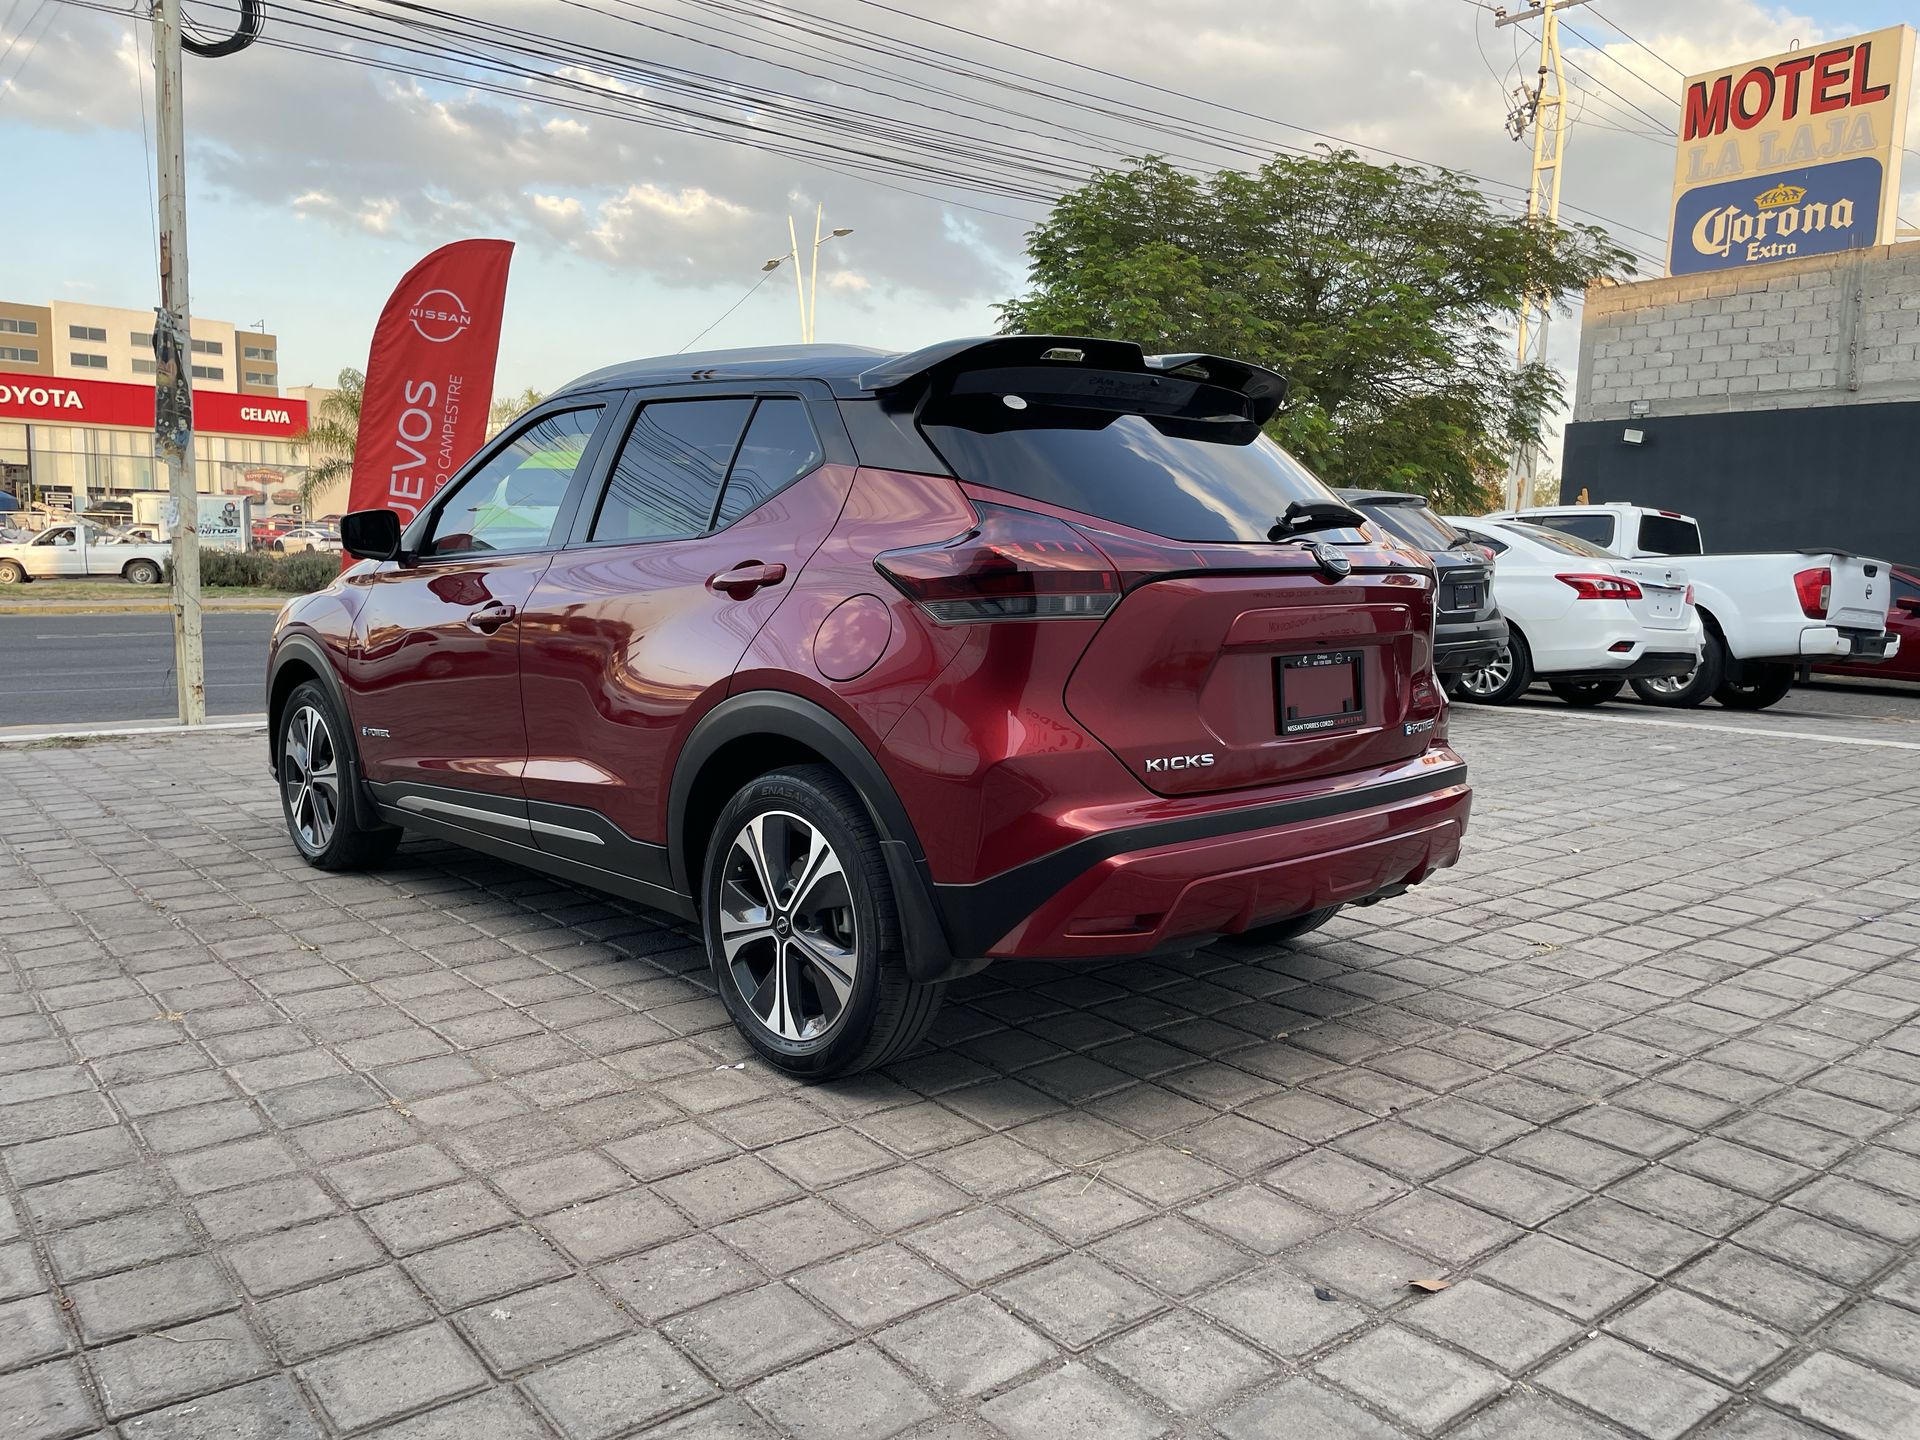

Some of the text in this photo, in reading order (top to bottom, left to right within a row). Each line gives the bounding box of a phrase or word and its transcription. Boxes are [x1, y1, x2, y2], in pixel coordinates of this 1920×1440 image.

[1683, 41, 1891, 142] MOTEL
[1685, 112, 1878, 184] LA LAJA
[1691, 198, 1855, 258] Corona
[1746, 242, 1797, 262] Extra
[409, 308, 471, 325] NISSAN
[0, 385, 291, 424] OYOTA CELAYA
[438, 374, 463, 470] CAMPESTRE
[387, 380, 437, 532] UEVOS
[1287, 724, 1303, 732] NISSAN
[1304, 721, 1319, 730] TORRES
[1145, 753, 1215, 773] KICKS
[761, 784, 815, 809] ENASAVE
